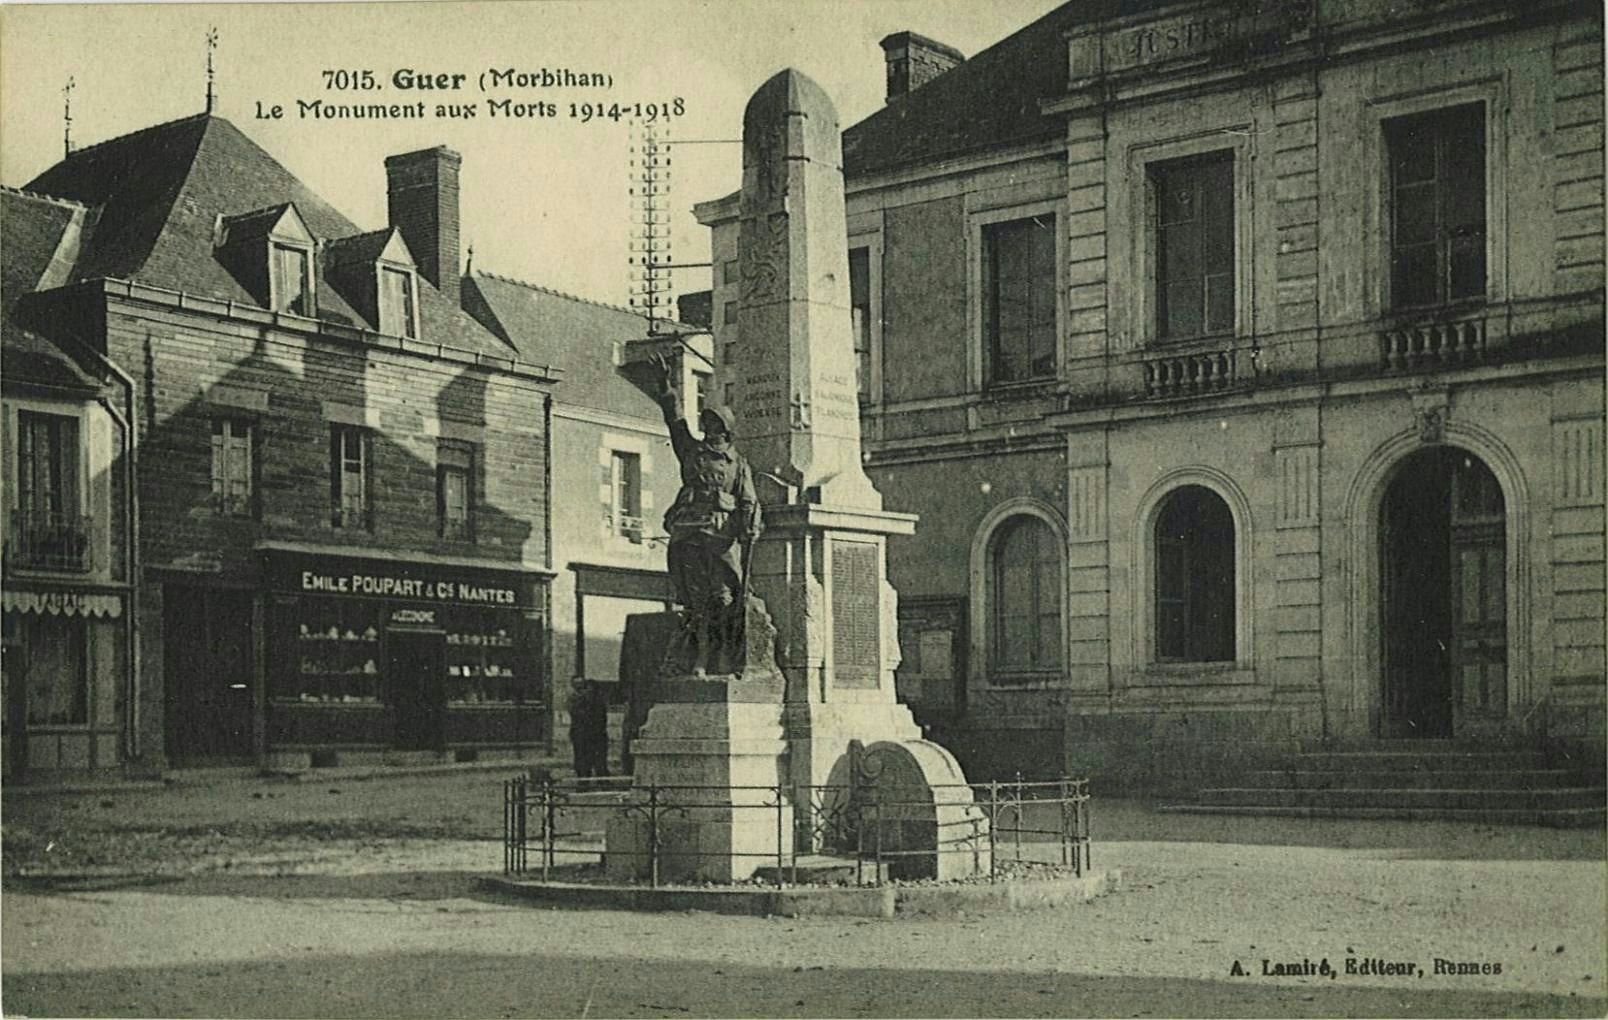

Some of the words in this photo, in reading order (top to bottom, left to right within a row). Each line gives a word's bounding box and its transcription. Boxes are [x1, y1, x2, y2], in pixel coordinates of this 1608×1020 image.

[303, 571, 348, 592] EMILE
[352, 574, 424, 598] POUPART
[459, 583, 516, 604] NANTES
